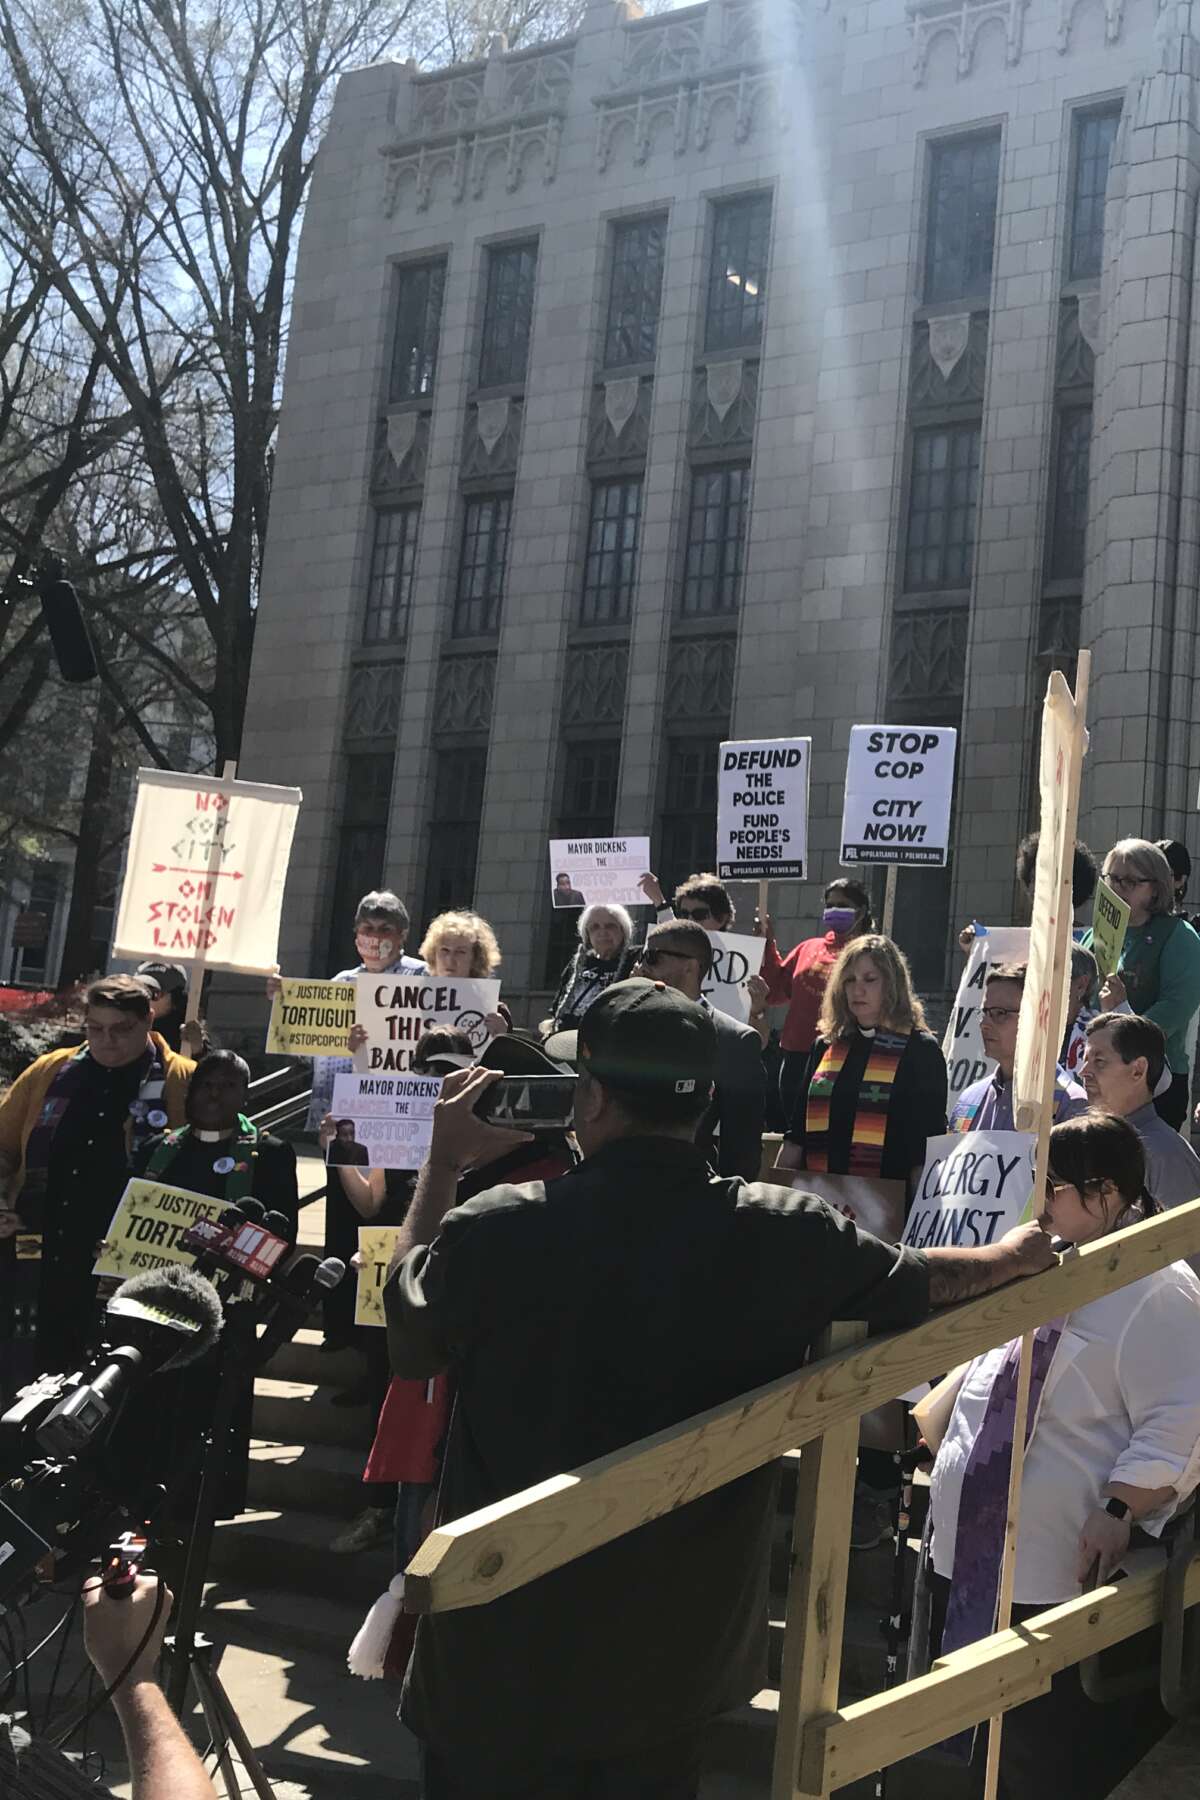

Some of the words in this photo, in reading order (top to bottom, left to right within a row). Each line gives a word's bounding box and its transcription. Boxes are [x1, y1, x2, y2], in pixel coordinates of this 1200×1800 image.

[867, 732, 939, 754] STOP
[724, 749, 802, 771] DEFUND
[875, 761, 924, 779] COP
[746, 773, 772, 787] THE
[196, 792, 228, 811] NO
[733, 791, 785, 806] POLICE
[872, 799, 923, 818] CITY
[186, 816, 230, 836] COP
[743, 814, 779, 828] FUND
[730, 829, 790, 844] PEOPLE'S
[863, 823, 927, 842] NOW!
[171, 839, 236, 863] CITY
[568, 842, 593, 854] MAYOR
[594, 841, 627, 853] DICKENS
[736, 845, 783, 859] NEEDS!
[596, 857, 607, 866] THE
[178, 880, 213, 900] ON
[147, 901, 236, 928] STOLEN
[1098, 892, 1122, 931] DEFEND
[153, 927, 217, 950] LAND
[296, 985, 333, 1000] JUSTICE
[335, 987, 354, 1002] FOR
[374, 985, 461, 1012] CANCEL
[282, 1006, 356, 1028] TORTUGUIT
[289, 1033, 350, 1047] #STOPCOPCIT
[948, 1058, 987, 1092] OP
[359, 1080, 394, 1095] MAYOR
[396, 1081, 440, 1097] DICKENS
[395, 1102, 409, 1115] THE
[922, 1152, 1021, 1201] CLERGY
[155, 1193, 217, 1219] JUSTICE
[905, 1208, 1004, 1249] AGAINST
